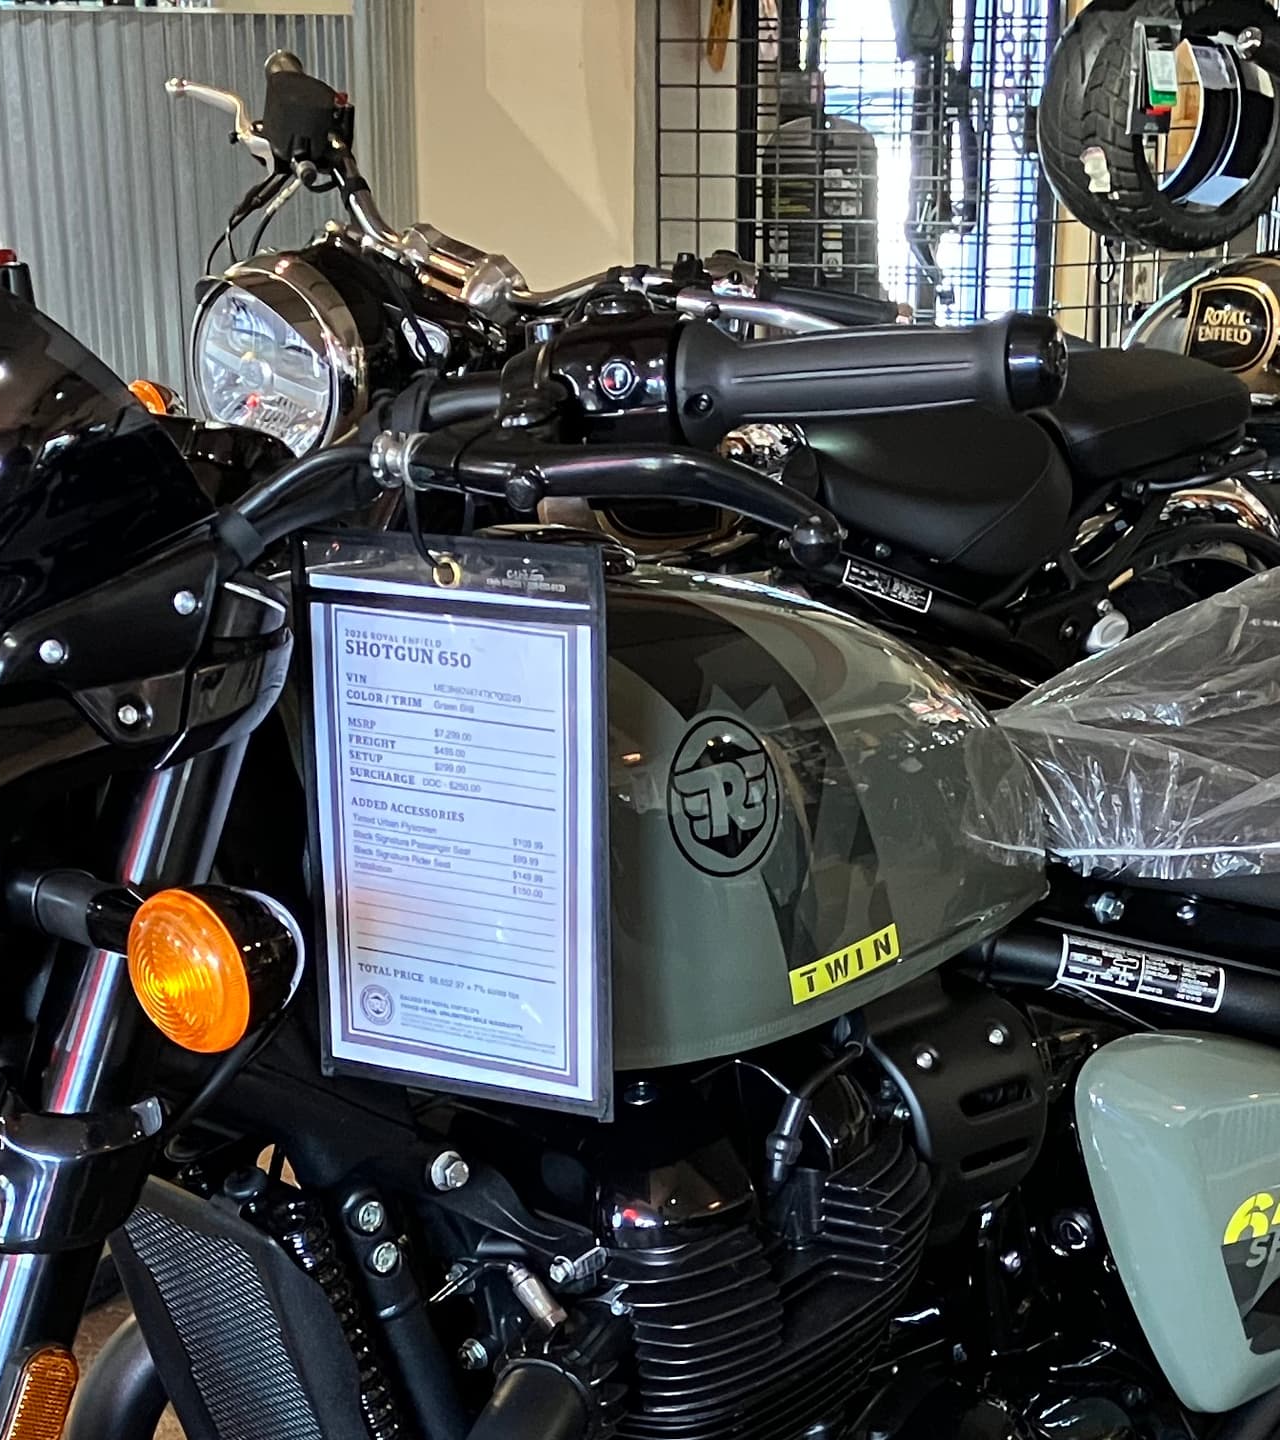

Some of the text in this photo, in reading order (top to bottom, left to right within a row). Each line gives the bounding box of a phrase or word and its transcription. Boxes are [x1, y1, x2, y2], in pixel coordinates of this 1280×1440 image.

[1203, 306, 1247, 326] ROYAL
[1198, 325, 1252, 346] ENFIELD
[370, 631, 398, 643] ROYAL
[402, 636, 442, 648] ENFIELD
[345, 639, 471, 669] SHOTGUN 650
[346, 672, 367, 684] VIN
[346, 689, 383, 703] COLOR
[392, 696, 422, 708] TRIM
[348, 717, 376, 729] MSRP
[348, 734, 396, 749] FREIGHT
[349, 749, 383, 763] SETUP
[350, 766, 415, 785] SURCHARGE
[352, 796, 464, 822] ADDED ACCESSORIES
[799, 932, 891, 993] TWIN
[358, 962, 392, 977] TOTAL
[394, 969, 424, 983] PRICE
